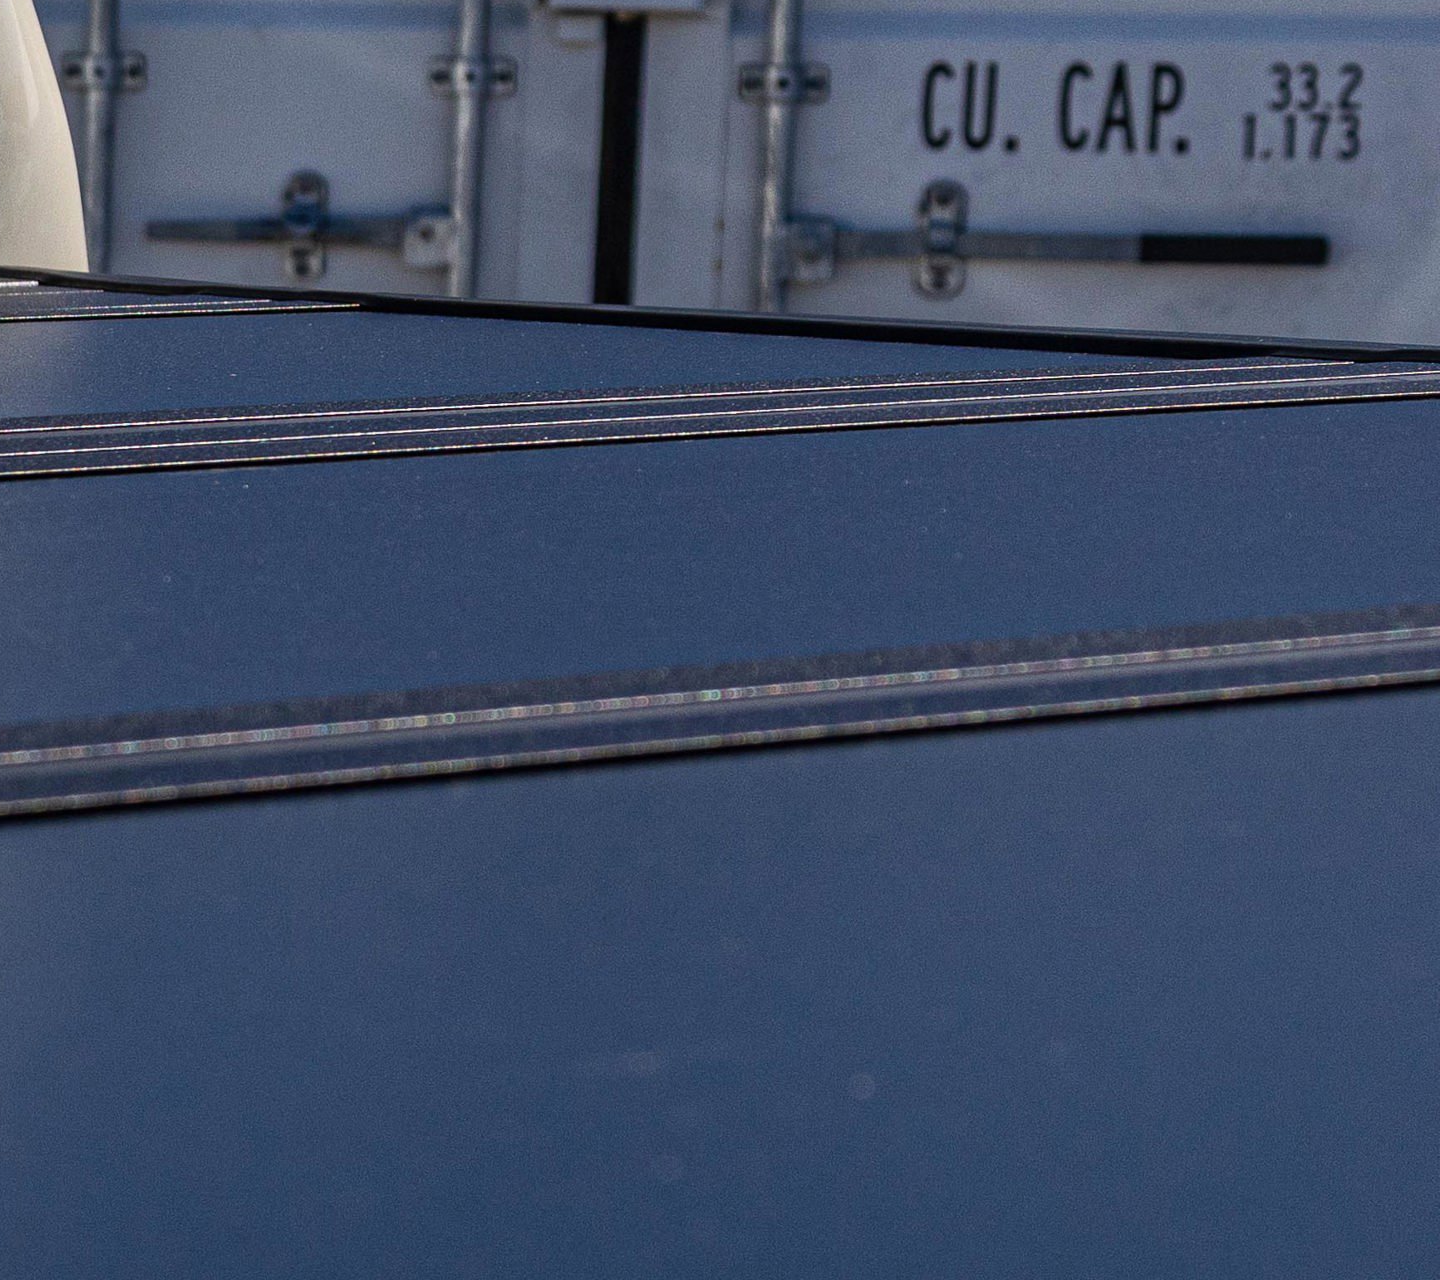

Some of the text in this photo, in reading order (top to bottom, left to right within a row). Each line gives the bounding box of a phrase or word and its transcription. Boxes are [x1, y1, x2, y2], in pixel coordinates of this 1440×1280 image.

[920, 60, 1365, 156] CU. CAP. 33.2
[1240, 112, 1363, 162] 1.173
